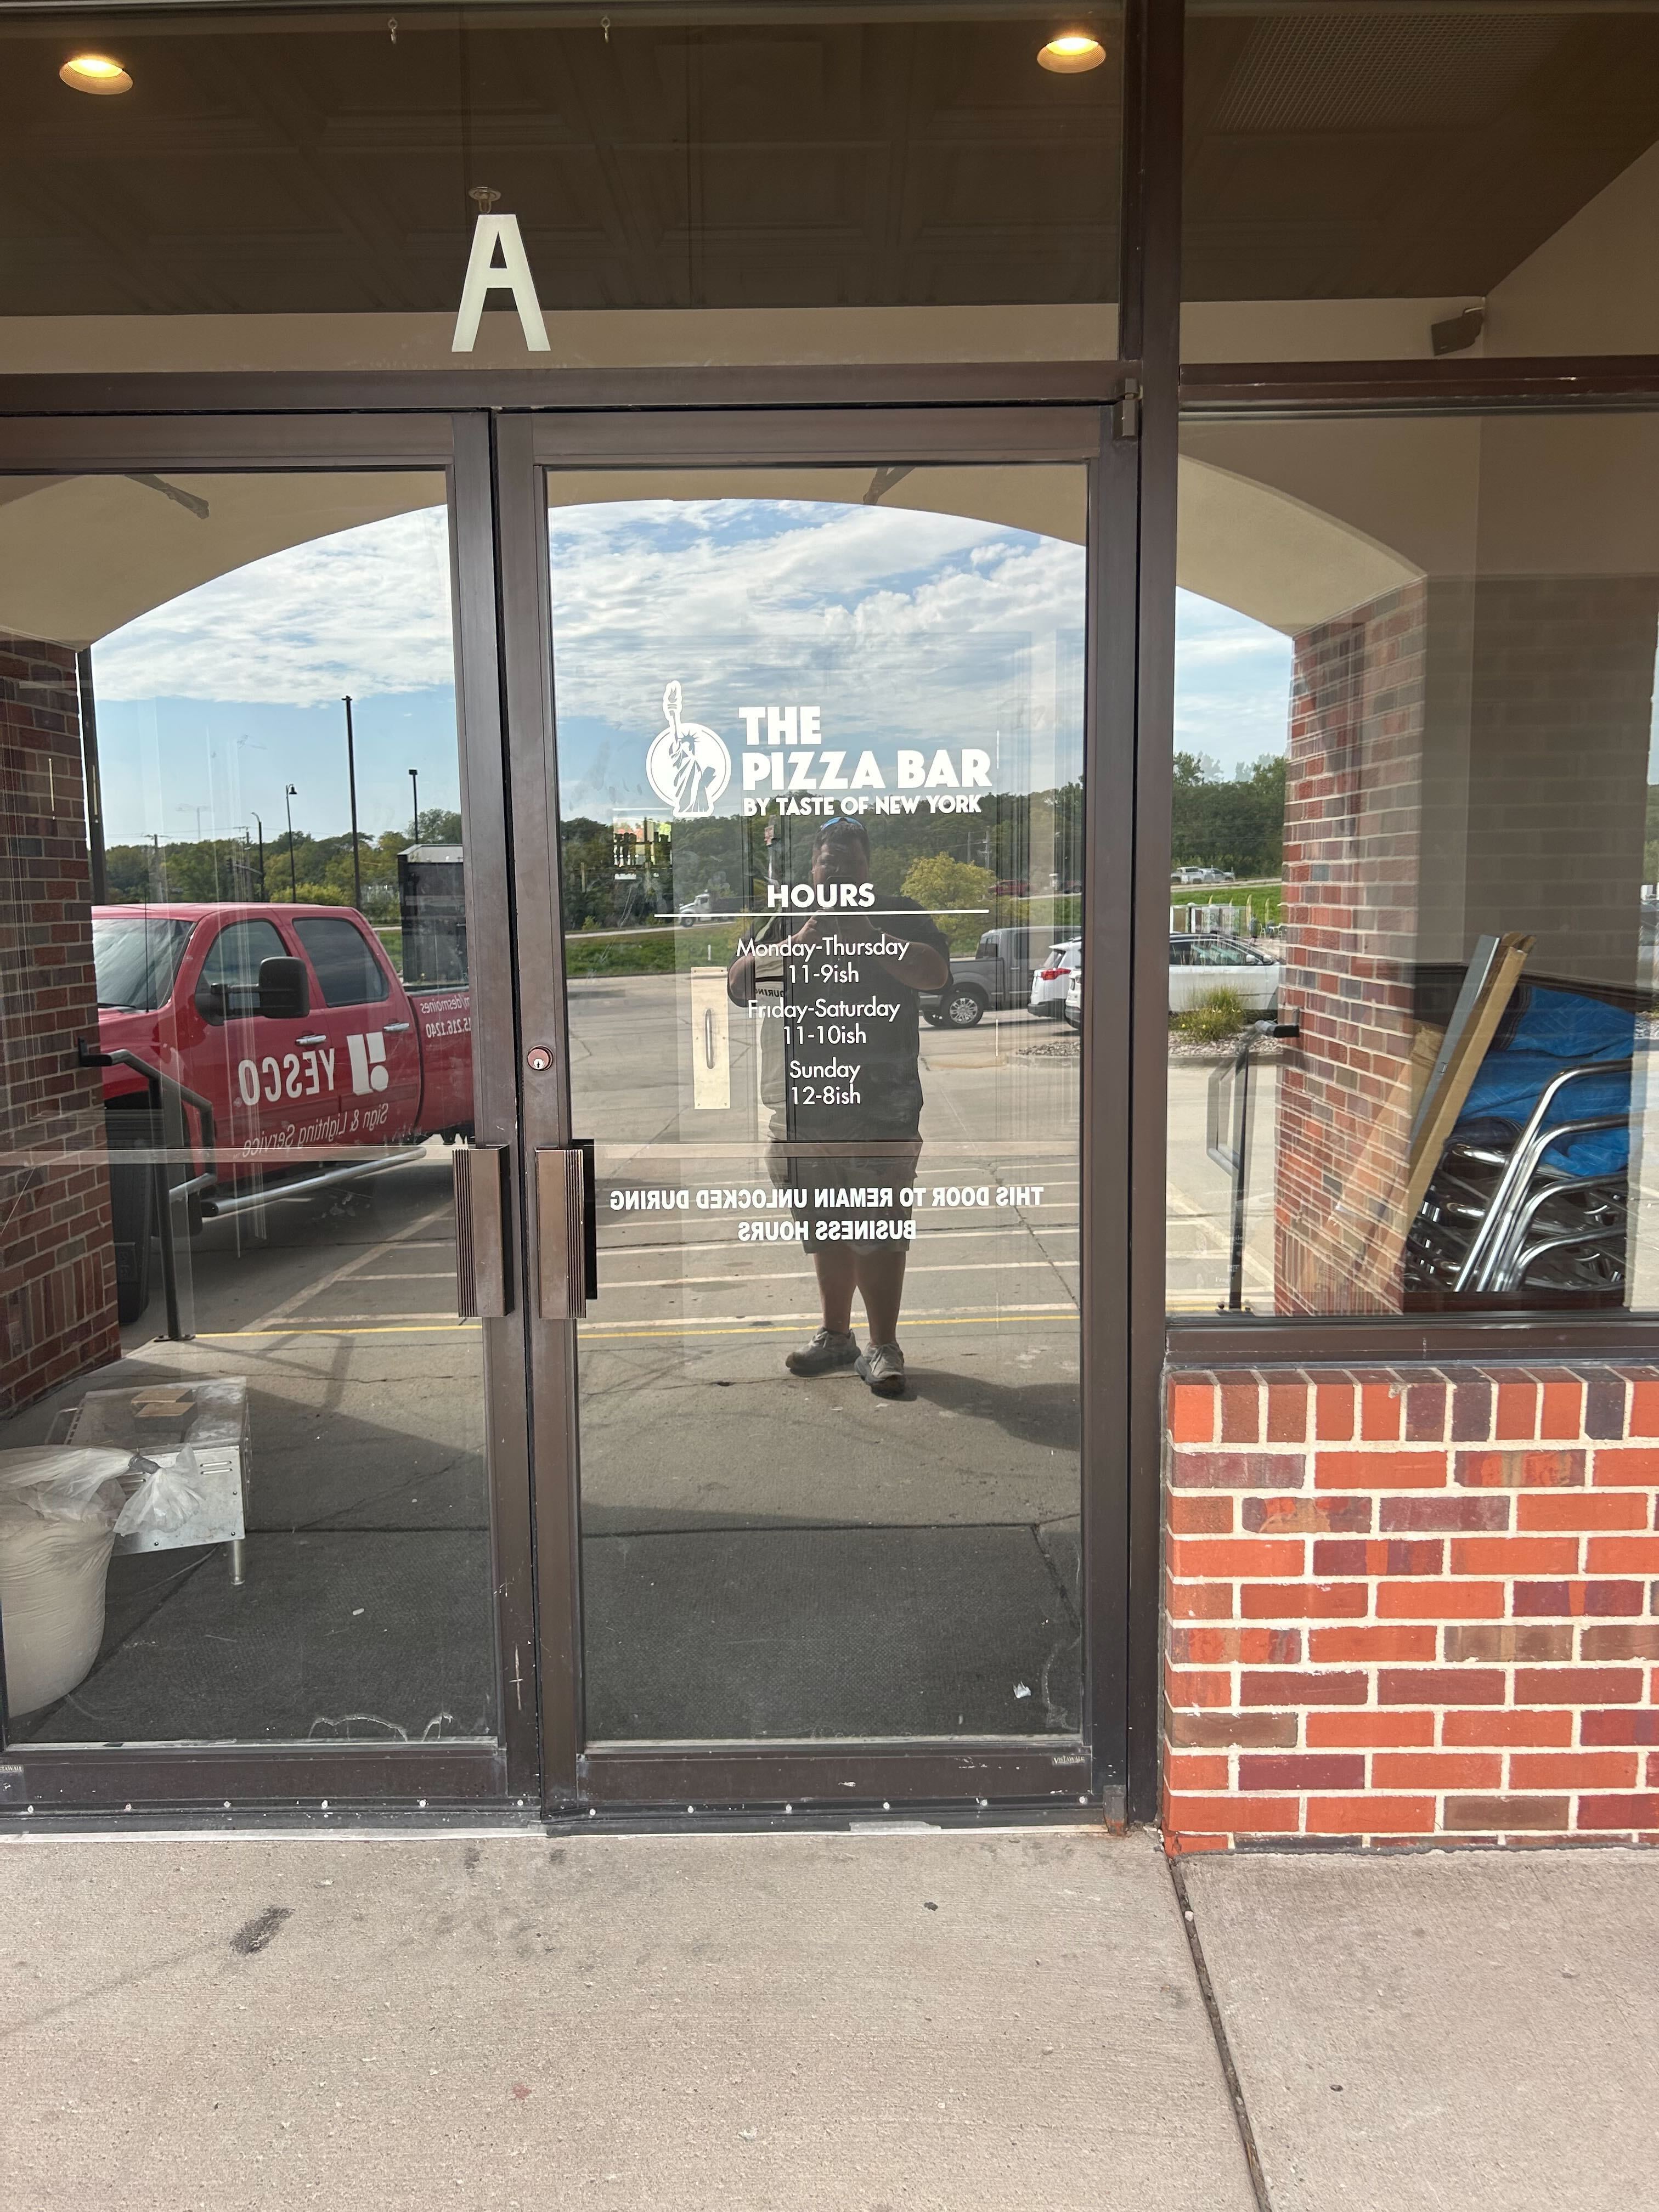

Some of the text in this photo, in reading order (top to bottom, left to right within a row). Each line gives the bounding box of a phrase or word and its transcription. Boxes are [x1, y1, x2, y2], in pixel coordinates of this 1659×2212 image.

[452, 214, 551, 352] A
[738, 706, 821, 745] THE
[742, 749, 992, 791] PIZZA BAR
[743, 794, 981, 816] BY TASTE OF NEW YORK
[767, 883, 875, 908] HOURS
[736, 933, 910, 962] Monday-Thursday
[789, 962, 859, 984] 11-9ish
[748, 996, 900, 1022] Friday-Saturday
[783, 1022, 866, 1045] 11-10ish
[789, 1057, 861, 1084] Sunday
[791, 1084, 861, 1105] 12-8ish
